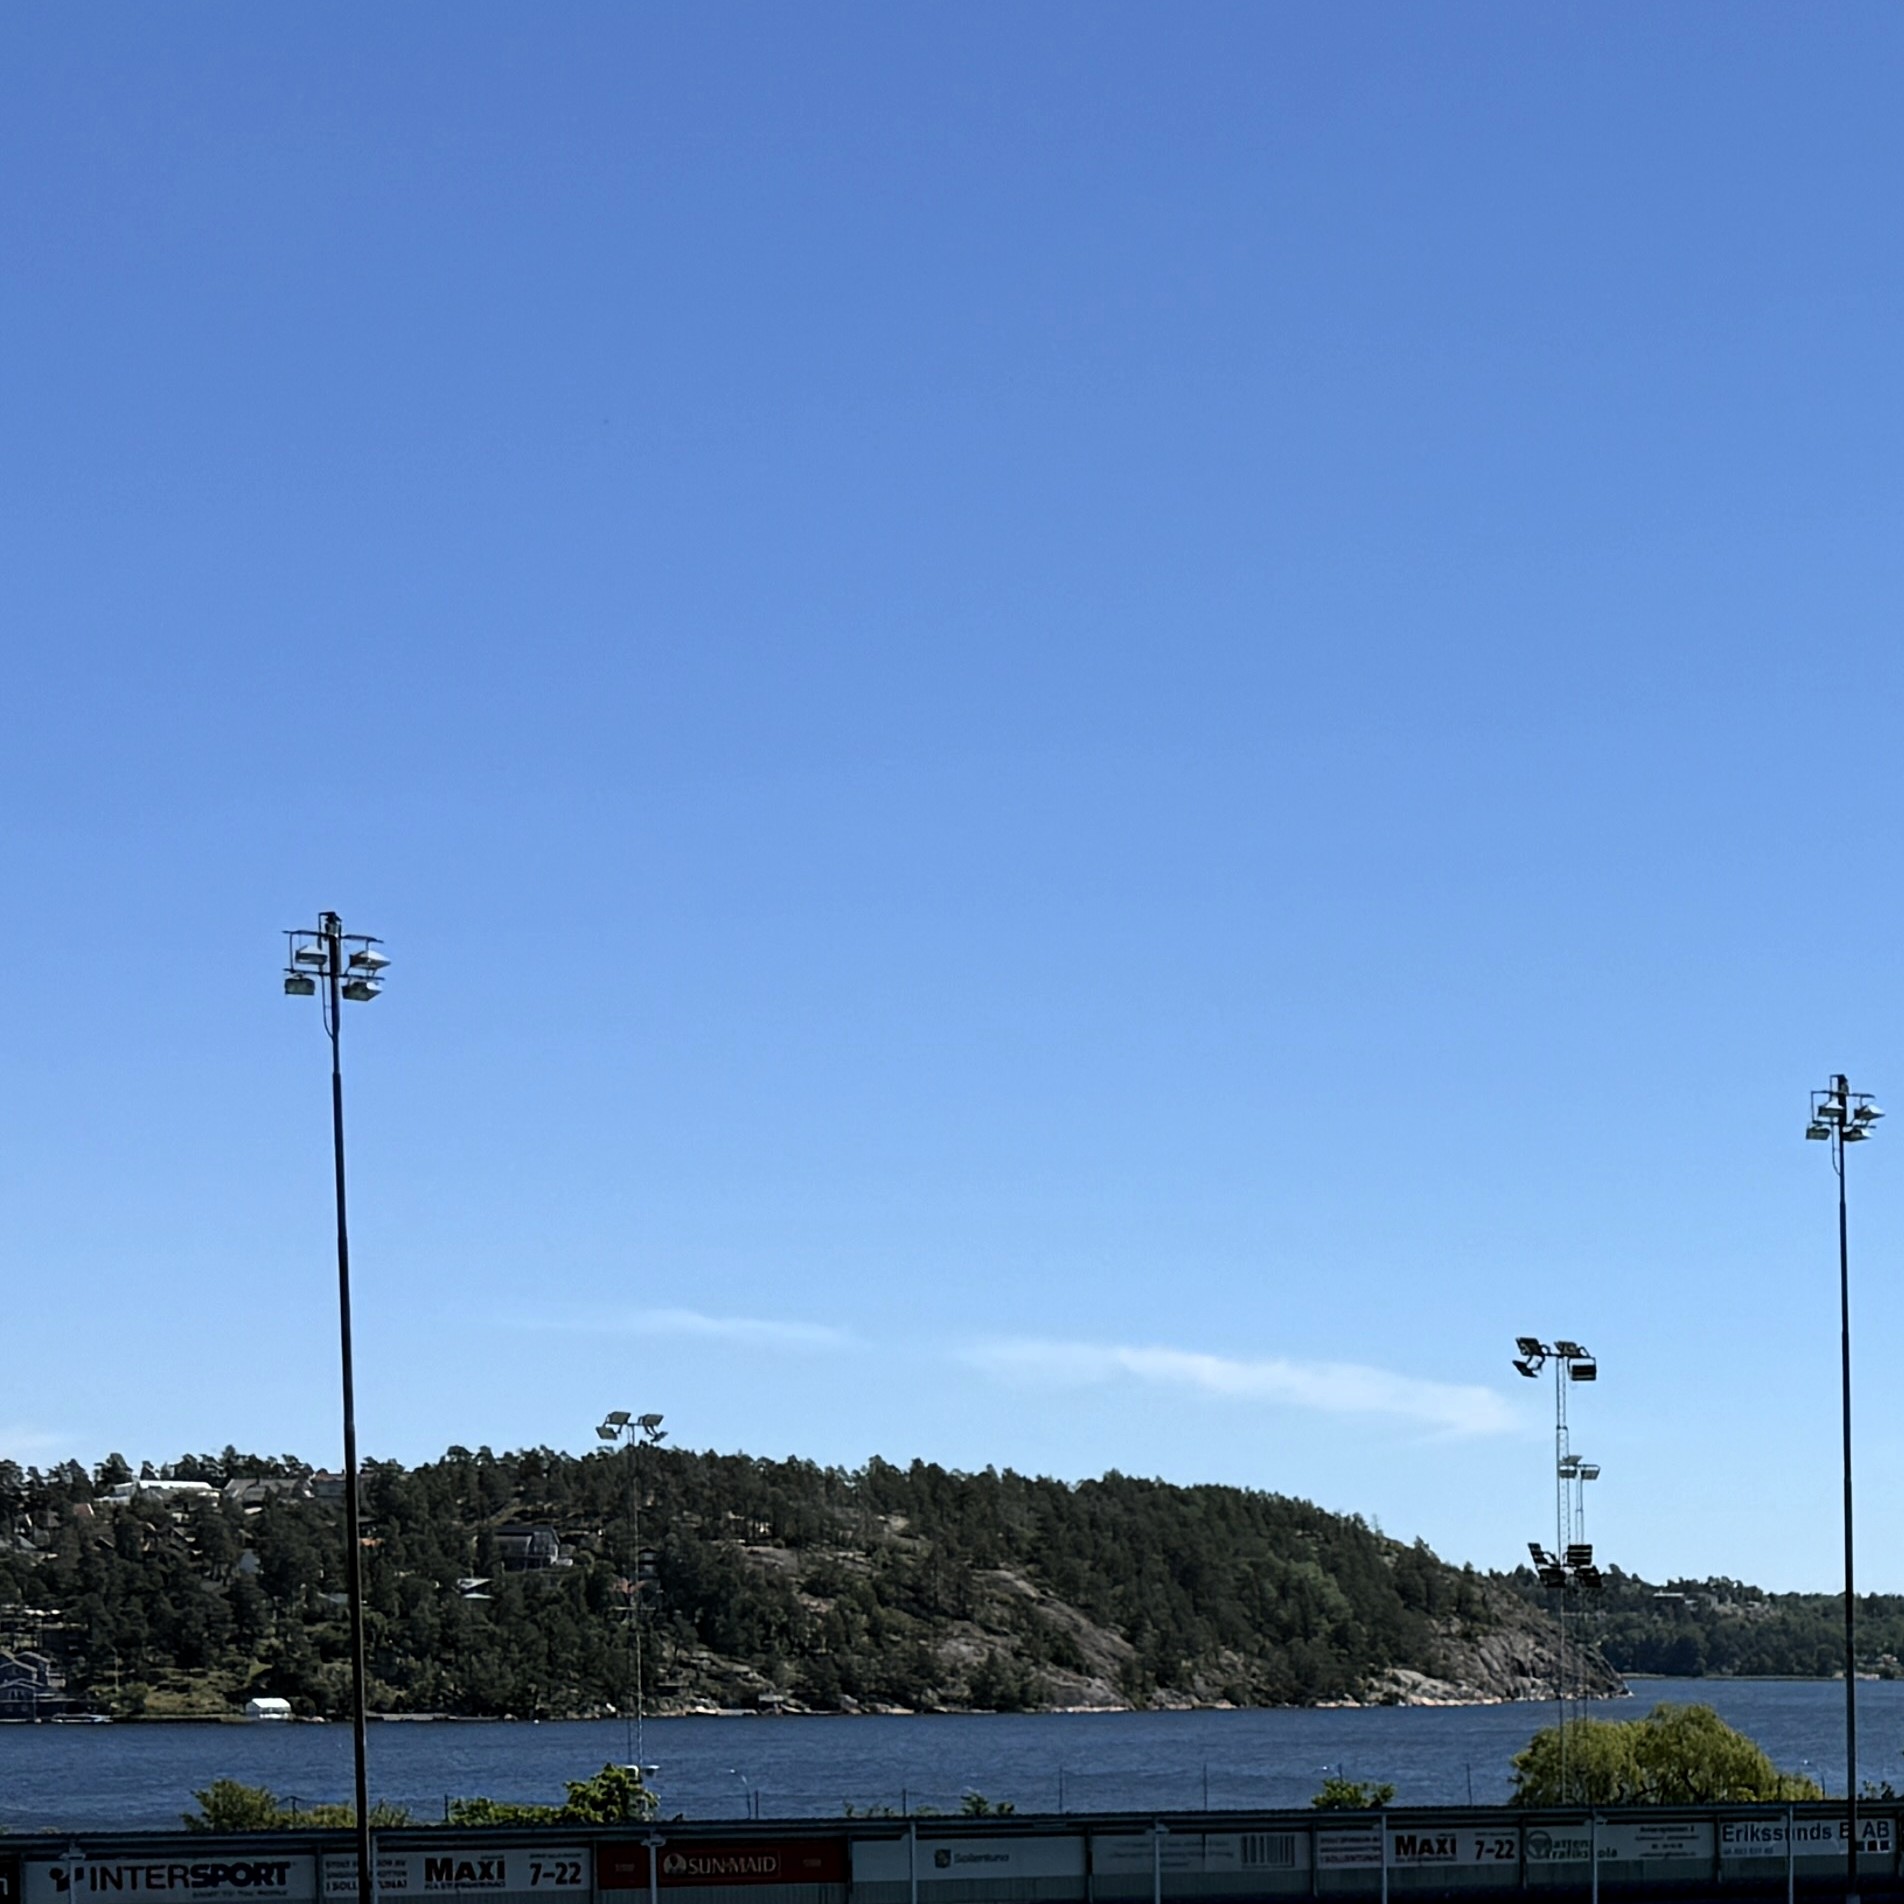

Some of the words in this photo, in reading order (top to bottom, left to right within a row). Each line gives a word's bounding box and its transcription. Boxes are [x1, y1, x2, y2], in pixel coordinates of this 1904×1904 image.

[1721, 1822, 1833, 1842] Erikssnds
[1861, 1821, 1890, 1839] AB
[90, 1861, 292, 1891] INTERSPORT
